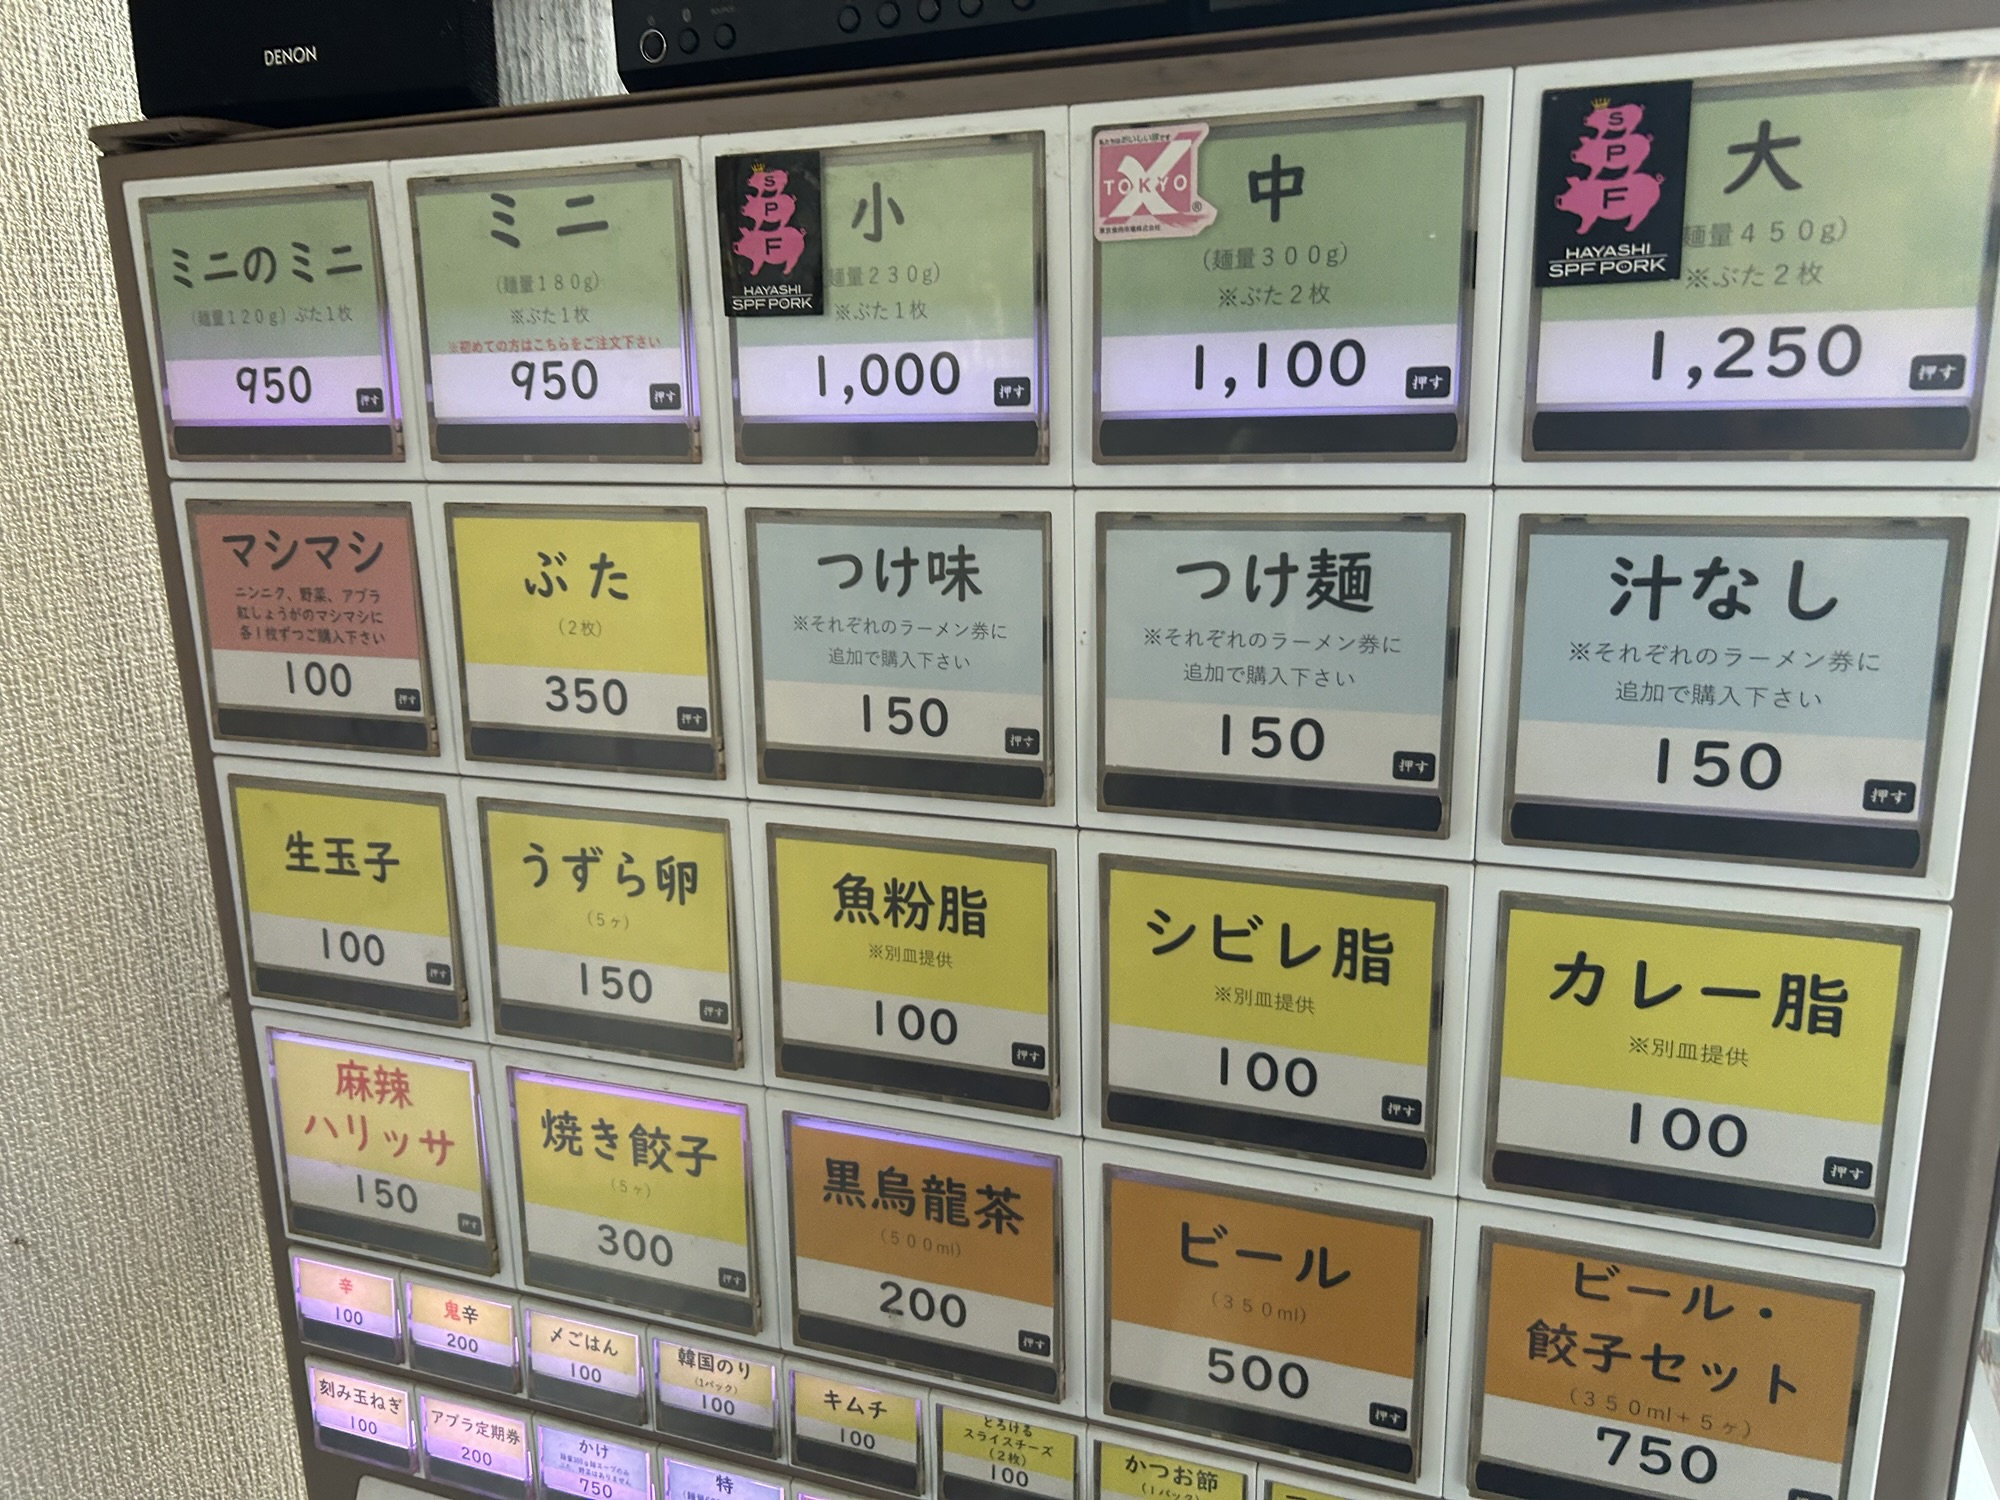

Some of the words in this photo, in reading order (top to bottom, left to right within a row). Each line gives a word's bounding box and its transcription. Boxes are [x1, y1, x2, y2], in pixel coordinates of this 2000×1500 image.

[264, 45, 318, 66] DENON
[1723, 119, 1803, 195] 大
[1103, 174, 1187, 196] TOKYO
[1248, 153, 1305, 223] 中
[490, 192, 609, 249] ミニ
[851, 181, 905, 243] 小
[172, 241, 363, 289] ミニのミニ
[1202, 241, 1349, 272] (麺量300g)
[1548, 261, 1597, 278] SPF
[1599, 258, 1667, 275] PORK
[1565, 243, 1651, 260] HAYASHI
[732, 298, 767, 311] SPF
[768, 297, 813, 310] PORK
[744, 284, 802, 296] HAYASHI
[1217, 281, 1331, 309] ※ぶた2枚
[1194, 338, 1366, 399] 1,100
[1650, 323, 1862, 389] 1,250
[1917, 363, 1957, 382] 押す
[236, 365, 312, 404] 950
[511, 359, 598, 401] 950
[817, 351, 961, 405] 1,000
[999, 384, 1025, 399] 押す
[1411, 373, 1444, 391] 押す
[222, 529, 384, 573] マシマシ
[524, 551, 629, 600] ぶた
[817, 543, 983, 602] つけ味
[1176, 547, 1374, 613] つけ麺
[1609, 553, 1838, 621] 汁なし
[558, 619, 603, 637] (2枚)
[792, 614, 1007, 641] ※それぞれのラーメン券に
[1143, 626, 1401, 655] ※それぞれのラーメン券に
[828, 647, 970, 670] 追加で購入下さい
[1568, 640, 1881, 674] ※それぞれのラーメン券に
[286, 660, 352, 697] 100
[1182, 662, 1355, 688] 追加で購入下さい
[545, 675, 628, 716] 350
[1614, 679, 1822, 709] 追加で購入下さい
[863, 693, 948, 738] 150
[1009, 734, 1034, 748] 押す
[1221, 713, 1325, 761] 150
[1398, 758, 1429, 774] 押す
[1657, 737, 1782, 790] 150
[1870, 786, 1908, 806] 押す
[285, 830, 400, 883] 生玉子
[523, 842, 698, 906] うずら卵
[832, 872, 988, 938] 魚粉脂
[322, 927, 385, 966] 100
[868, 943, 953, 968] ※別皿提供
[1146, 908, 1394, 987] シビレ脂
[580, 962, 652, 1004] 150
[1214, 984, 1316, 1015] ※別皿提供
[1549, 950, 1849, 1038] カレー脂
[875, 1000, 958, 1046] 100
[1017, 1048, 1040, 1063] 押す
[1628, 1034, 1750, 1068] ※別皿提供
[336, 1058, 414, 1109] 麻辣
[1219, 1047, 1317, 1098] 100
[1386, 1101, 1416, 1118] 押す
[304, 1113, 455, 1167] ハリッサ
[541, 1108, 718, 1179] 焼き餃子
[1630, 1101, 1748, 1158] 100
[1830, 1164, 1864, 1182] 押す
[356, 1174, 418, 1214] 150
[822, 1157, 1024, 1236] 黒烏龍茶
[597, 1223, 673, 1267] 300
[881, 1227, 962, 1258] (500ml)
[1180, 1221, 1351, 1289] ビール
[338, 1276, 354, 1295] 辛
[1574, 1261, 1773, 1321] ビール・
[335, 1306, 363, 1326] 100
[443, 1299, 478, 1325] 鬼辛
[879, 1281, 967, 1329] 200
[1211, 1290, 1307, 1324] (350ml)
[446, 1333, 478, 1354] 200
[570, 1362, 602, 1384] 100
[677, 1347, 751, 1380] 韓国のり
[1207, 1346, 1309, 1399] 500
[1526, 1318, 1797, 1405] 餃子セット
[318, 1377, 402, 1416] 刻み玉ねぎ
[701, 1394, 735, 1416] 100
[823, 1389, 887, 1419] キムチ
[350, 1415, 378, 1435] 100
[431, 1409, 521, 1446] アブラ定期券
[984, 1416, 1032, 1437] とろける
[1374, 1409, 1401, 1425] 押す
[579, 1439, 609, 1459] かけ
[840, 1427, 876, 1450] 100
[963, 1428, 1053, 1457] スライスチーズ
[1596, 1425, 1718, 1485] 750
[461, 1446, 493, 1467] 200
[989, 1448, 1026, 1467] (2枚)
[579, 1477, 613, 1499] 750
[716, 1474, 733, 1495] 特
[992, 1464, 1028, 1487] 100
[1125, 1455, 1218, 1493] かつお節
